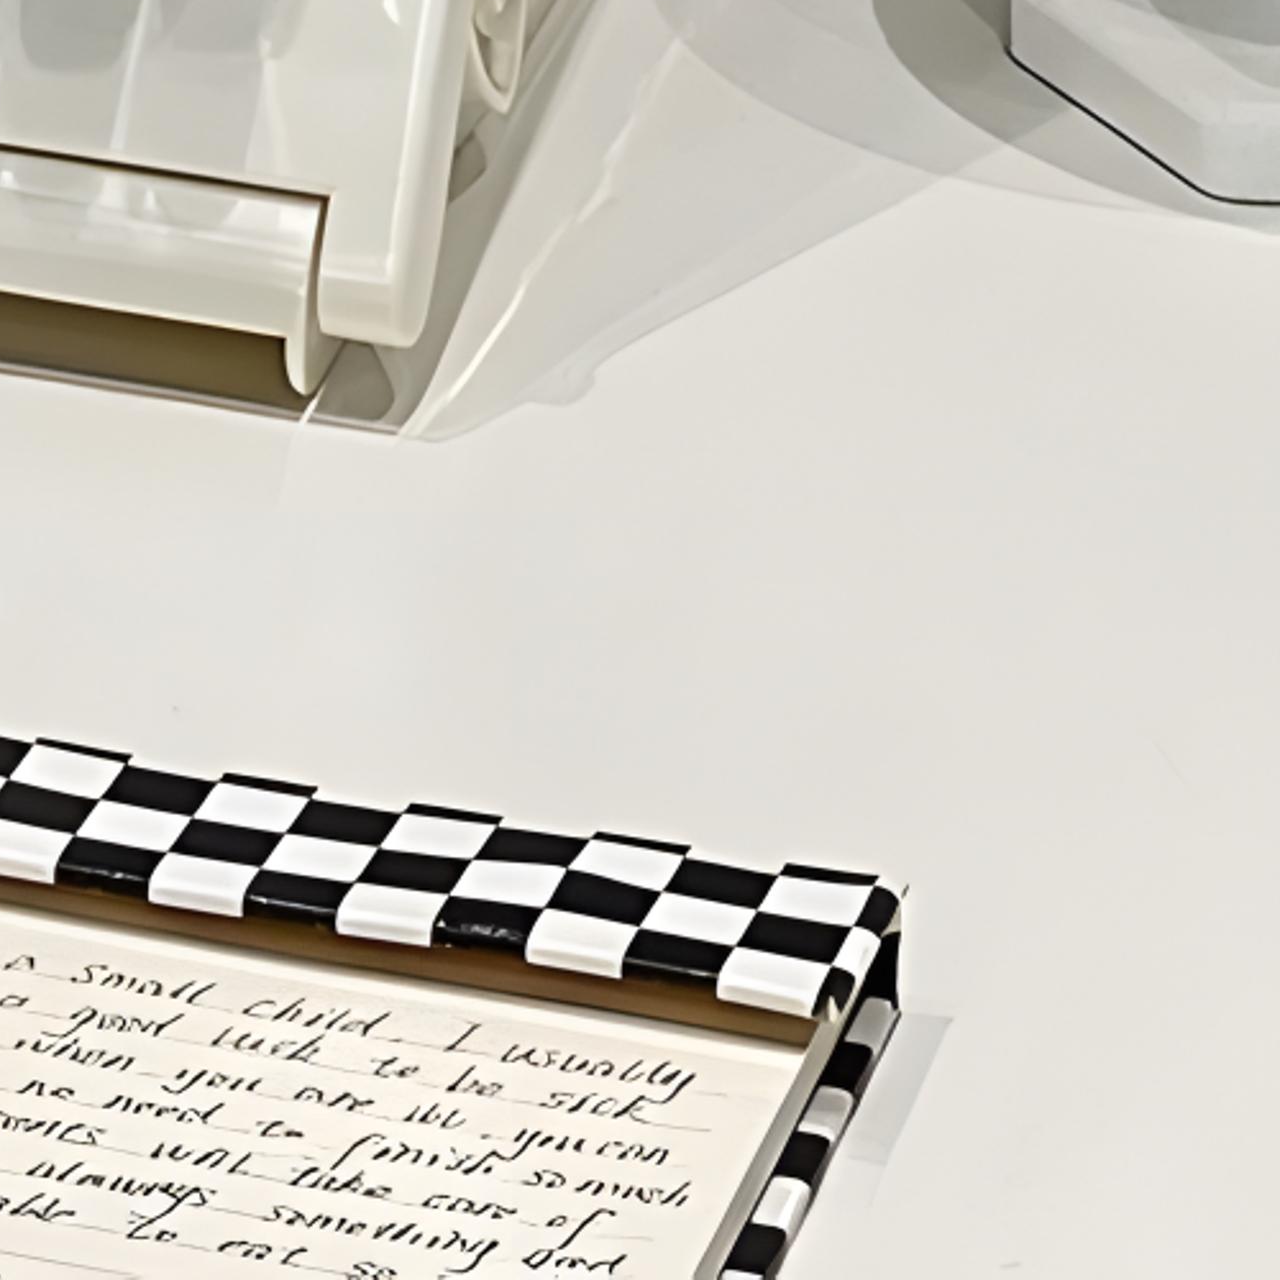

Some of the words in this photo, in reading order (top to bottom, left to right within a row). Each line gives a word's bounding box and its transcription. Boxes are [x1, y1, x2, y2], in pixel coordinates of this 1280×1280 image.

[41, 1006, 184, 1038] good
[212, 1026, 324, 1062] luck
[370, 1056, 419, 1079] to
[447, 1065, 503, 1096] be
[540, 1092, 649, 1125] sick
[71, 964, 217, 1005] small
[444, 1023, 480, 1052] I
[501, 1044, 696, 1104] usually
[18, 1080, 75, 1101] no
[103, 1094, 224, 1124] need
[256, 1120, 304, 1138] to
[330, 1133, 494, 1176] finish
[161, 1068, 261, 1094] you
[294, 1086, 374, 1112] are
[597, 1141, 670, 1166] can
[126, 1210, 179, 1242] to
[422, 1194, 517, 1220] care
[545, 1208, 616, 1250] of
